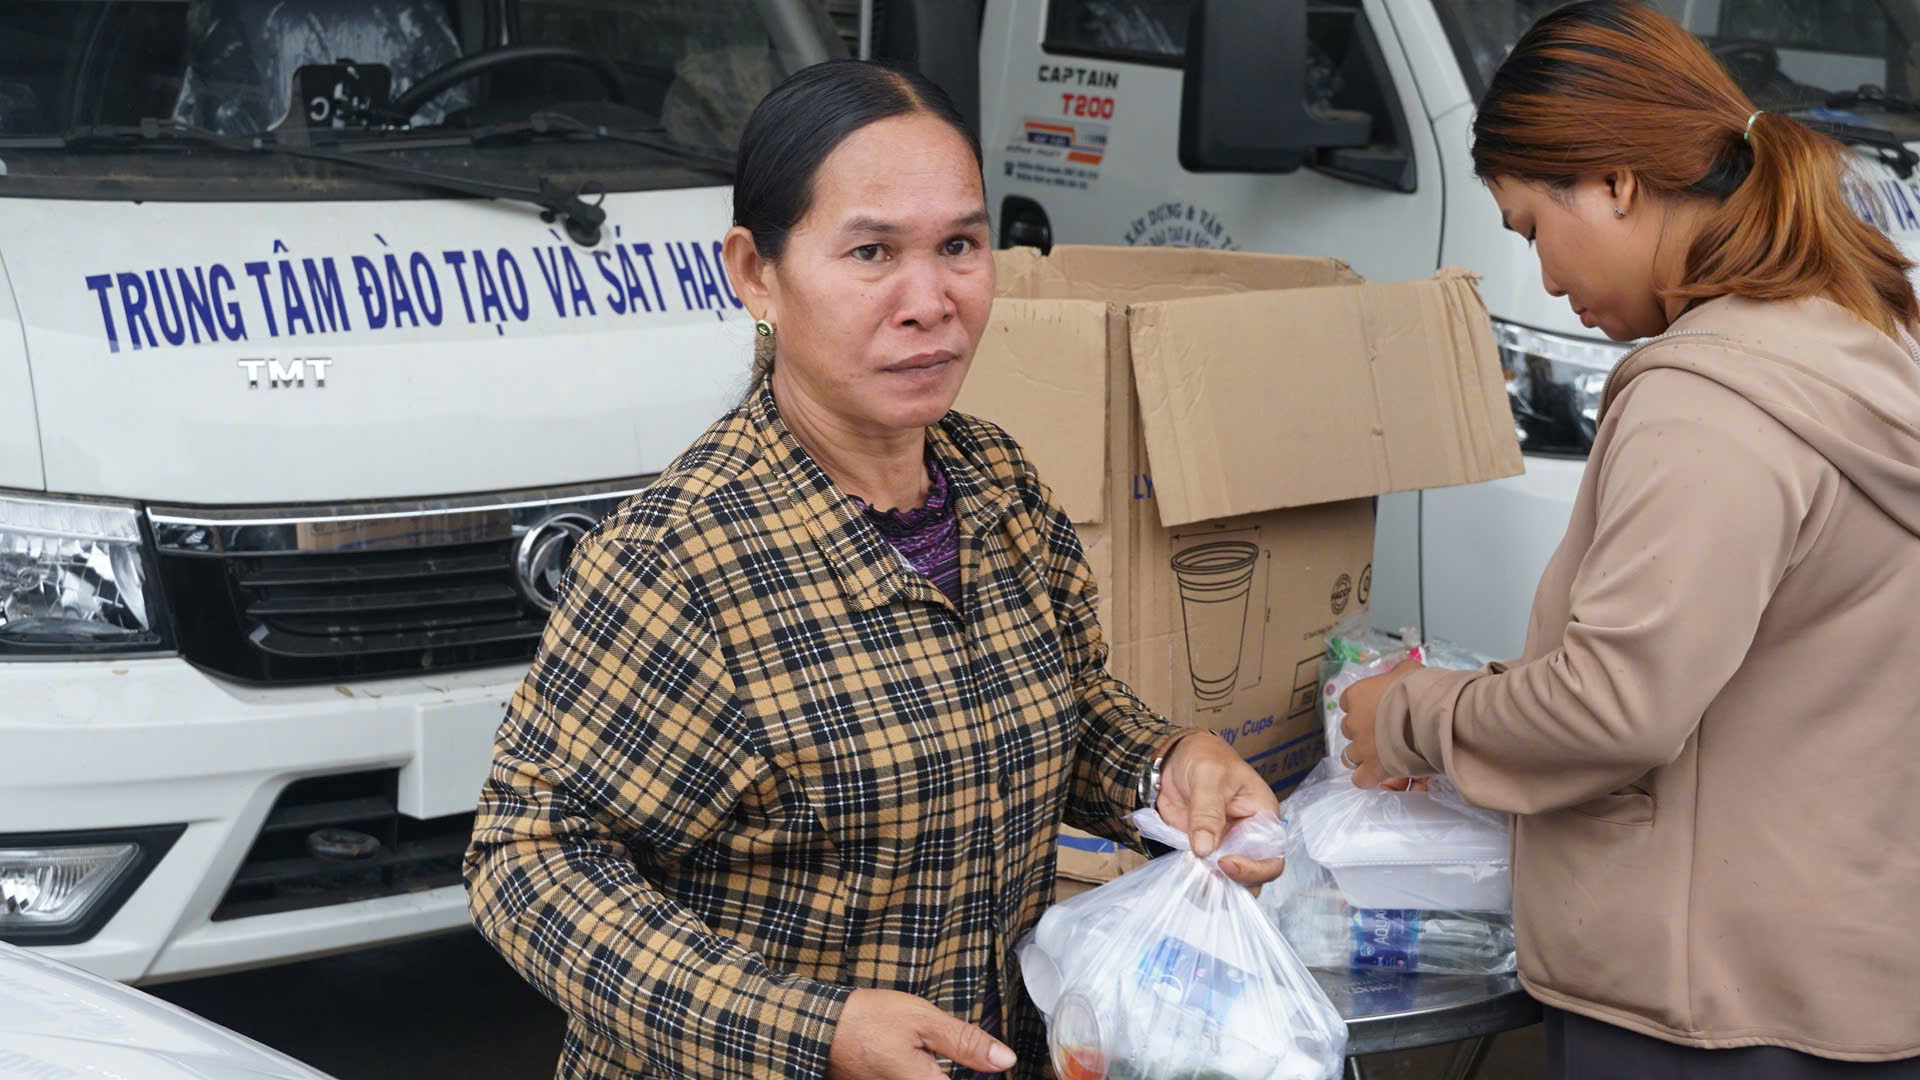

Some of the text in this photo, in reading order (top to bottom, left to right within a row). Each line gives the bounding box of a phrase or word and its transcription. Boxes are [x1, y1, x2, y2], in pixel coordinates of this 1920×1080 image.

[1038, 64, 1119, 89] CAPTAIN
[1060, 93, 1115, 120] T200
[85, 262, 248, 354] TRUNG
[244, 239, 352, 337] TÂM
[350, 233, 443, 330] ĐÀO
[443, 247, 530, 336] TẠO
[532, 228, 597, 318] VÀ
[594, 225, 667, 315] SÁT
[238, 357, 333, 389] TMT
[1242, 715, 1274, 737] Cups
[1373, 909, 1392, 946] AQUA
